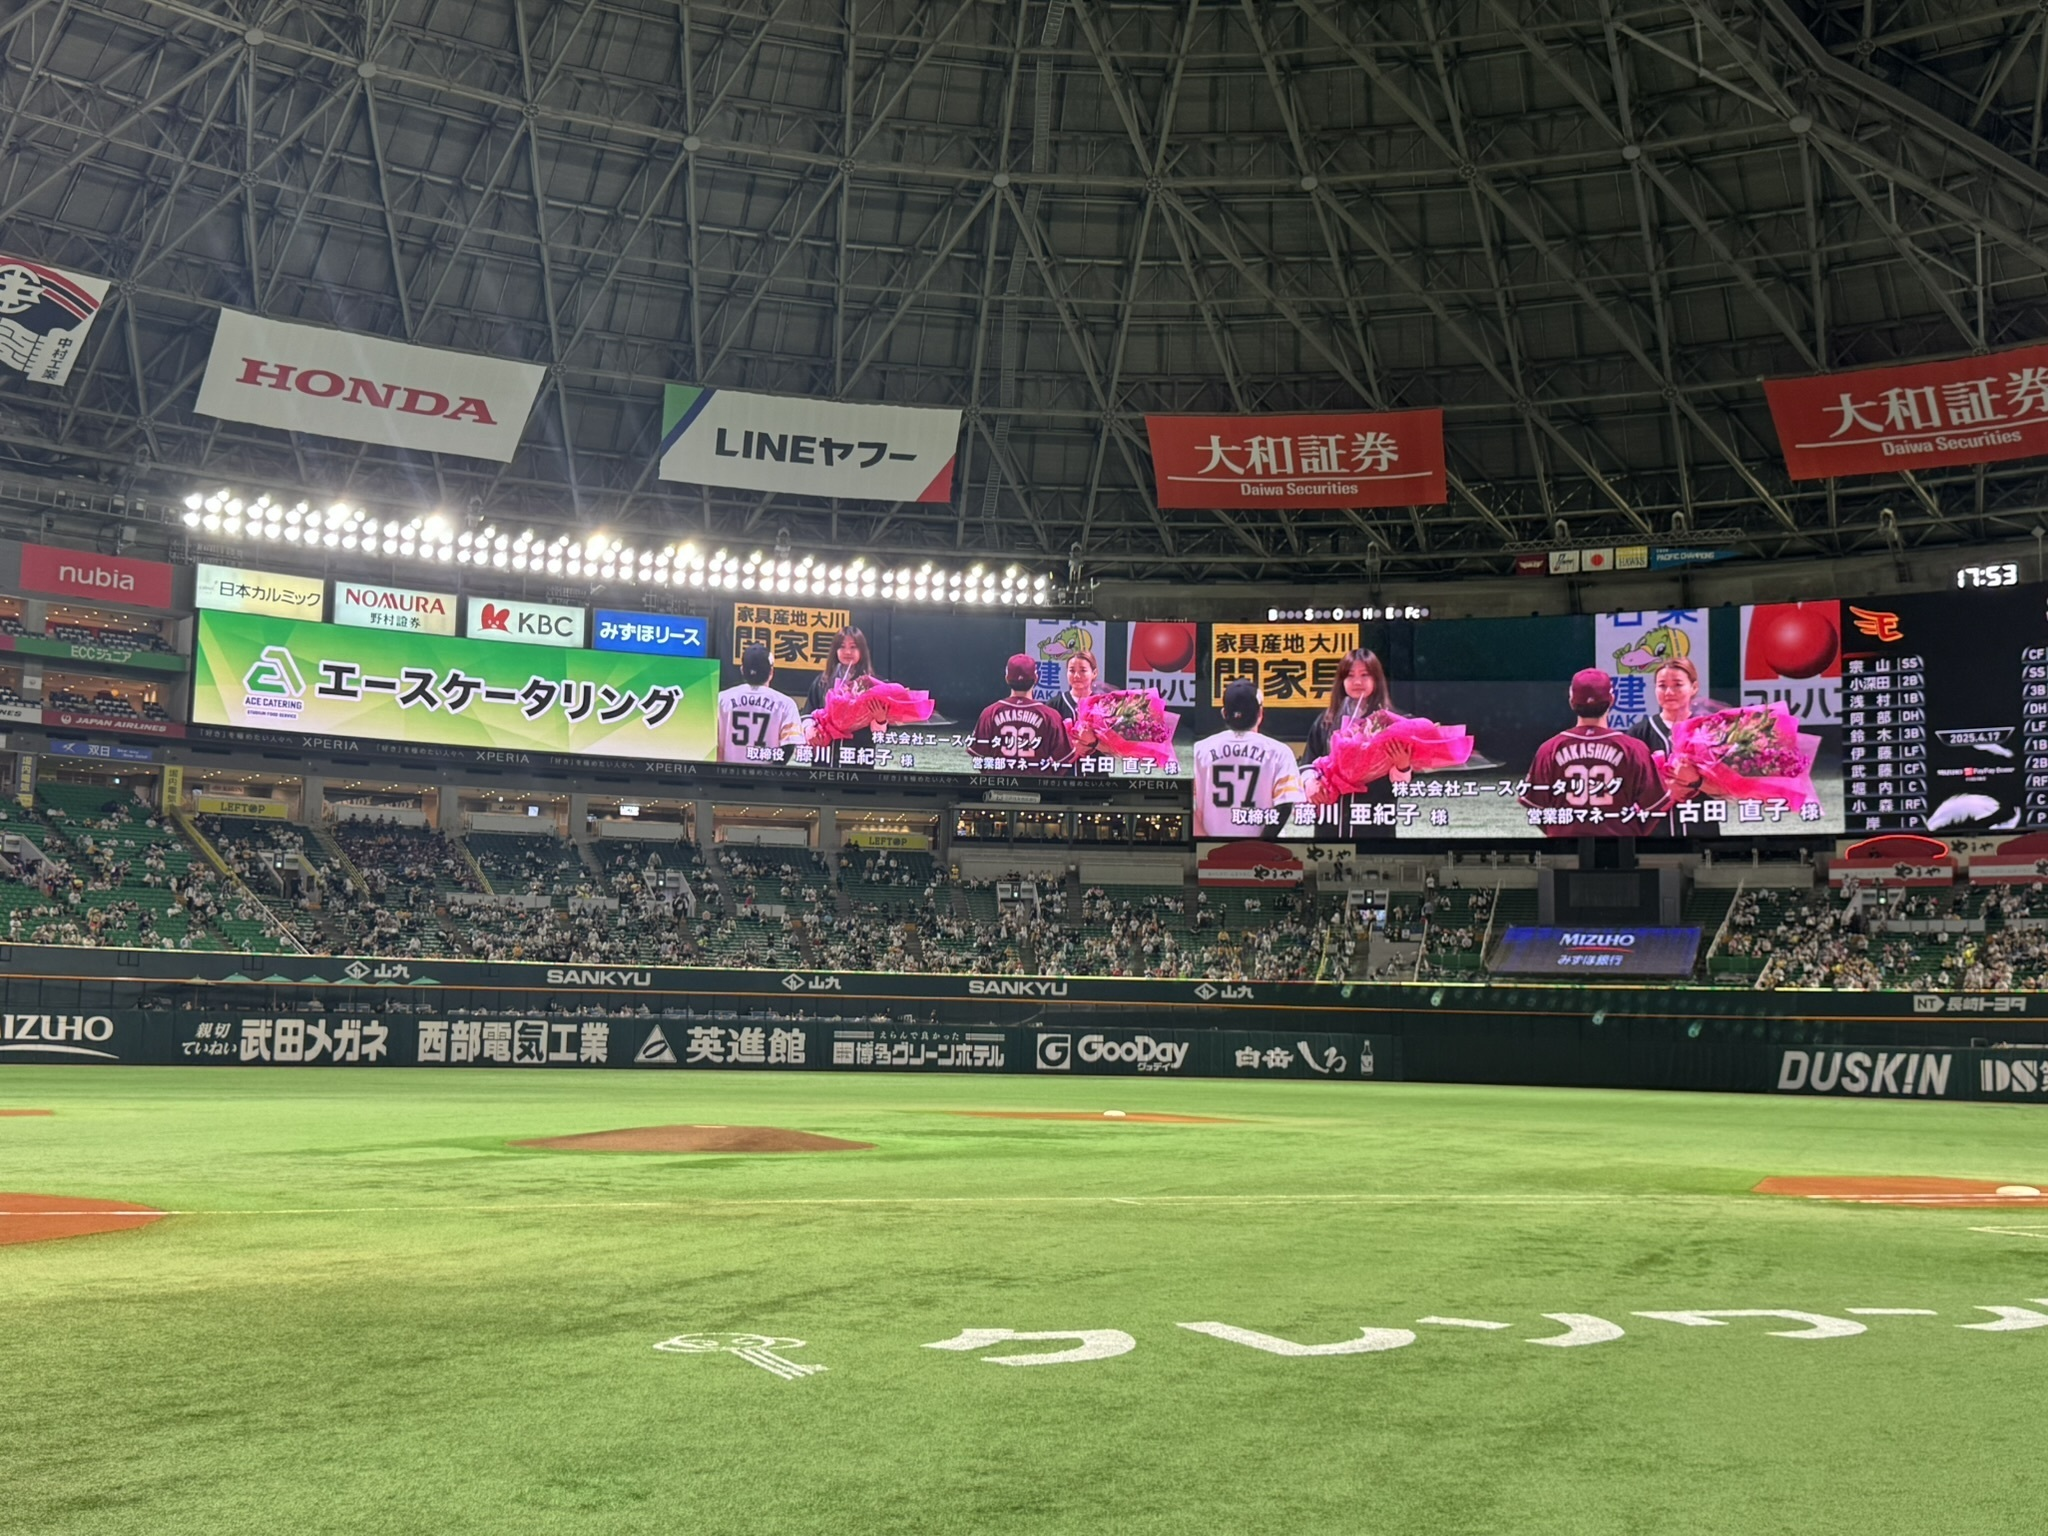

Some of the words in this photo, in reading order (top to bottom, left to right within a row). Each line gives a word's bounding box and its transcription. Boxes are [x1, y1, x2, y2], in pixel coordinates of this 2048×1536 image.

[235, 357, 498, 426] HONDA
[715, 427, 918, 469] LINEヤフー
[1881, 440, 1934, 456] Daiwa
[1935, 430, 2022, 453] Securities
[1194, 431, 1400, 476] 大和証券
[1241, 483, 1284, 496] Daiwa
[1286, 482, 1359, 496] Securities
[59, 565, 135, 590] nubia
[1957, 563, 2018, 588] 17:53
[219, 581, 321, 607] 日本カルミック
[345, 588, 446, 615] NOMURA
[737, 606, 808, 626] 家具産地
[810, 611, 846, 628] 大川
[1268, 608, 1278, 621] B
[1304, 608, 1314, 620] S
[1362, 607, 1373, 620] H
[518, 612, 574, 637] KBC
[600, 622, 701, 646] みずほリース
[1216, 633, 1305, 653] 家具産地
[1309, 633, 1353, 653] 大川
[71, 645, 132, 663] ECCジュニア
[2028, 648, 2044, 659] CF
[1902, 657, 1918, 669] SS
[2029, 667, 2045, 678] SS
[1850, 676, 1890, 690] 小深田
[1902, 675, 1918, 687] 2B
[318, 662, 681, 726] エースケータリング
[1903, 692, 1918, 704] 1B
[2030, 685, 2046, 696] 3B
[245, 697, 262, 706] ACE
[263, 698, 302, 710] CATERING
[731, 695, 776, 711] R.OGATA
[2030, 703, 2047, 714] DH
[994, 709, 1044, 729] NAKASHIMA
[1902, 710, 1919, 721] DH
[76, 717, 113, 727] JAPAN
[114, 720, 167, 733] AIRLINES
[731, 711, 771, 747] 57
[2031, 721, 2047, 732] LF
[872, 732, 1042, 750] 株式会社エースケータリング
[1850, 728, 1892, 743] 鈴木
[1904, 728, 1919, 739] 3B
[1950, 731, 2000, 744] 2025.4.17
[88, 744, 111, 757] 双日
[302, 737, 359, 751] XPERIA
[1904, 746, 1919, 757] LF
[2032, 739, 2048, 750] 1B
[476, 751, 530, 764] XPERIA
[746, 746, 785, 761] 取締役
[796, 746, 831, 764] 藤川
[839, 748, 893, 766] 亜紀子
[900, 754, 914, 768] 様
[1210, 744, 1266, 763] R.OGATA
[1555, 743, 1624, 767] NAKASHIMA
[646, 762, 697, 774] XPERIA
[972, 756, 1073, 772] 営業部マネージャー
[1079, 755, 1114, 773] 古田
[1122, 757, 1158, 773] 直子
[1165, 759, 1179, 774] 様
[1904, 763, 1920, 774] CF
[2032, 757, 2048, 768] 2B
[809, 770, 859, 782] XPERIA
[969, 776, 1019, 787] XPERIA
[2033, 776, 2048, 787] RF
[1128, 779, 1179, 790] XPERIA
[1212, 765, 1261, 808] 57
[1392, 777, 1623, 797] 株式会社エースケータリング
[1908, 781, 1917, 792] C
[1905, 799, 1921, 810] RF
[2037, 794, 2046, 804] C
[1231, 808, 1280, 825] 取締役
[1294, 803, 1339, 826] 藤川
[1350, 803, 1420, 826] 亜紀子
[1431, 808, 1448, 826] 様
[1527, 806, 1667, 825] 営業部マネージャー
[1676, 800, 1727, 823] 古田
[1738, 798, 1790, 822] 直子
[1800, 803, 1821, 821] 様
[2037, 812, 2046, 822] P
[1909, 816, 1918, 827] P
[1559, 933, 1635, 947] MIZUHO
[1557, 954, 1624, 966] みずほ銀行
[374, 964, 410, 979] 山九
[547, 969, 651, 986] SANKYU
[808, 976, 842, 990] 山九
[968, 980, 1067, 996] SANKYU
[1221, 984, 1254, 999] 山九
[0, 1013, 114, 1042] IZUHO
[195, 1022, 231, 1039] 親切
[240, 1018, 389, 1062] 武田メガネ
[417, 1020, 609, 1064] 西部電気工業
[879, 1031, 960, 1041] えらんで良かった
[181, 1041, 237, 1056] ていねい
[686, 1026, 806, 1064] 英進館
[1077, 1034, 1190, 1069] GooDay
[856, 1041, 1005, 1067] 博多グリーンホテル
[1137, 1062, 1171, 1072] グッデイ
